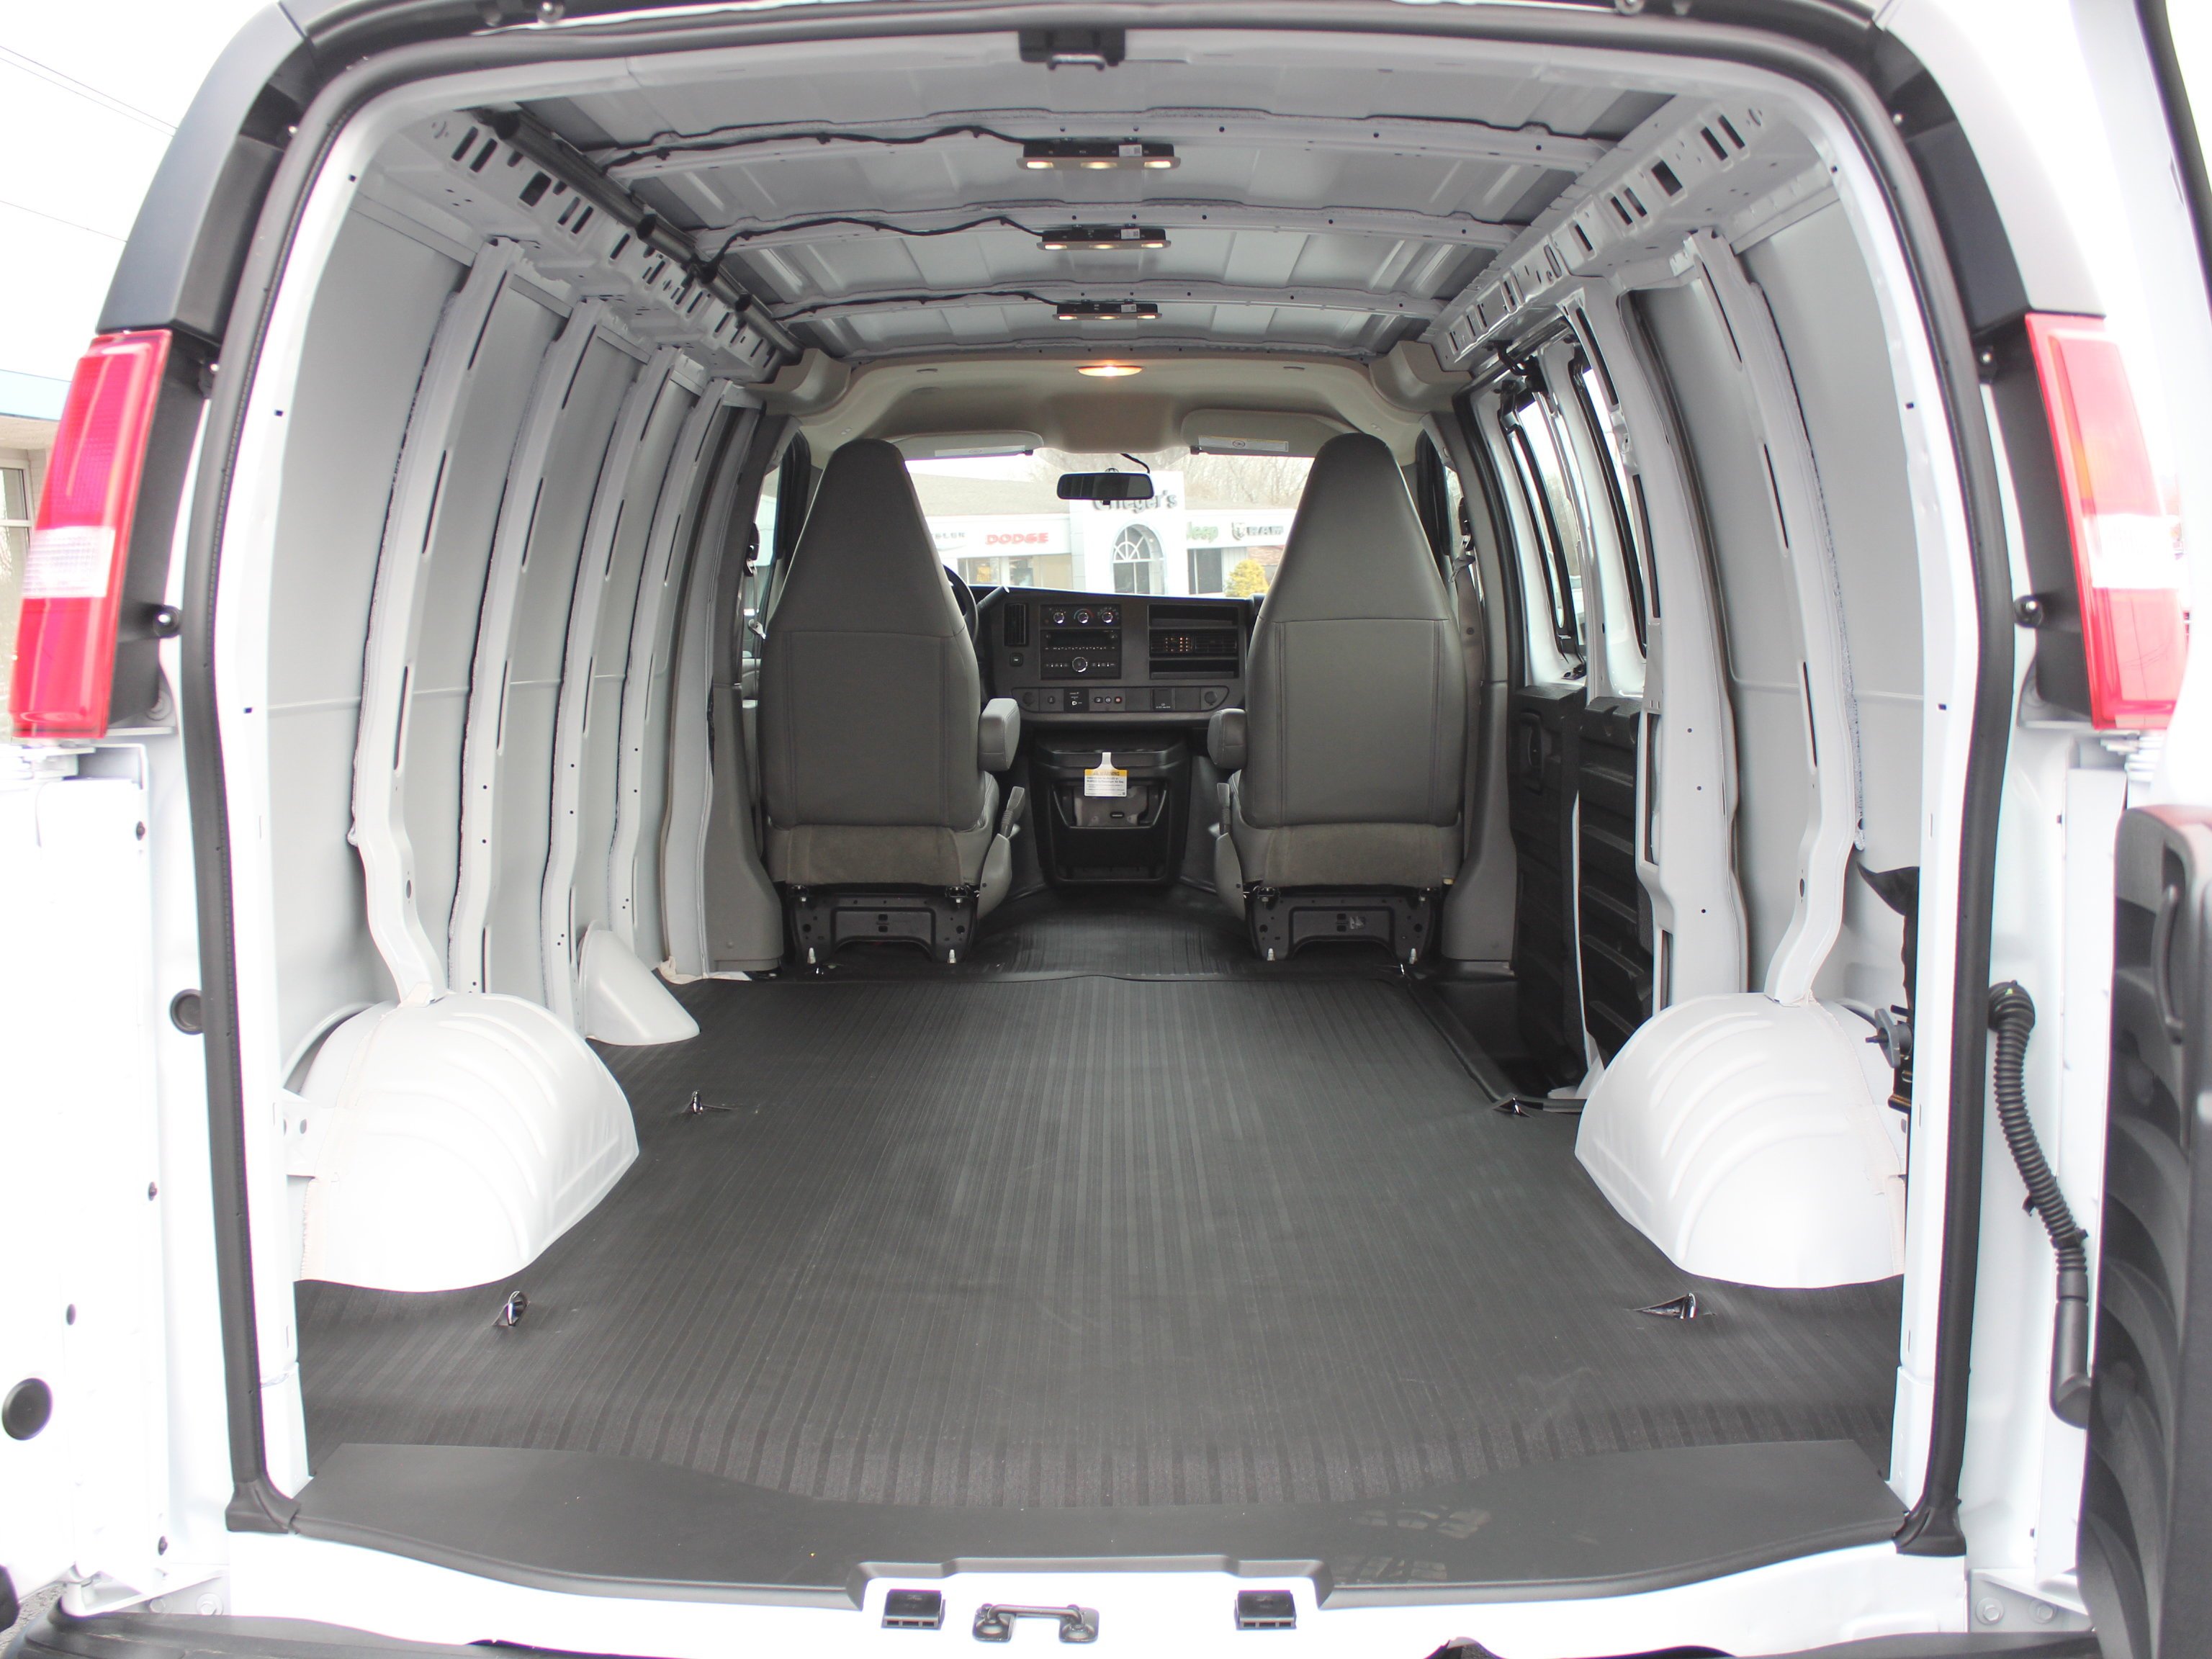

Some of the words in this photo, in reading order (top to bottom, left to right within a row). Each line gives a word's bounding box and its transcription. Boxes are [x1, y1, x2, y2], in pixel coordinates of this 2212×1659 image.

[1186, 521, 1218, 543] Jeep
[1246, 526, 1284, 536] RAM
[985, 532, 1049, 545] DODGE
